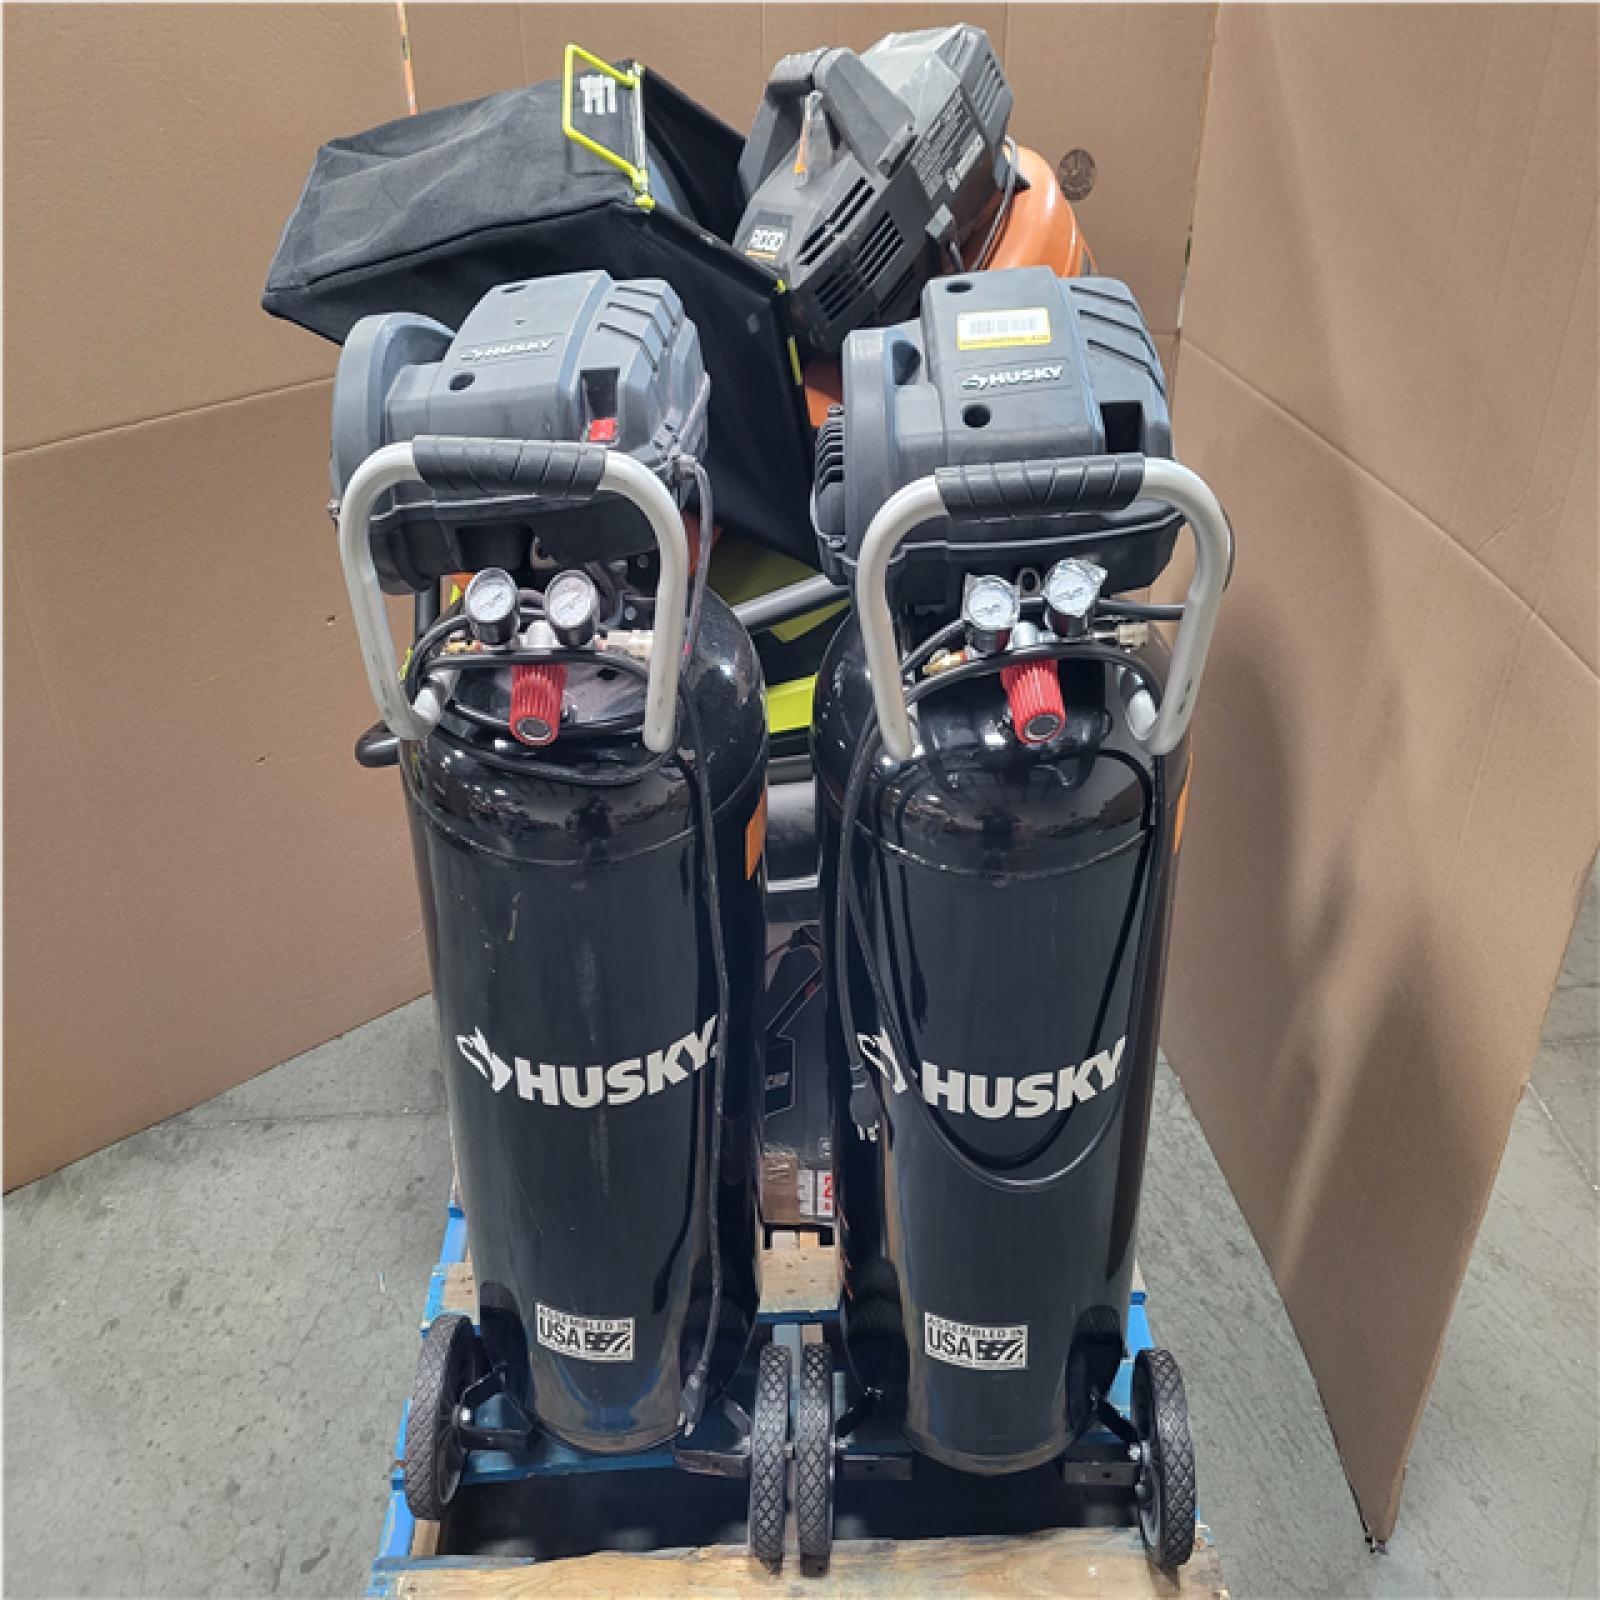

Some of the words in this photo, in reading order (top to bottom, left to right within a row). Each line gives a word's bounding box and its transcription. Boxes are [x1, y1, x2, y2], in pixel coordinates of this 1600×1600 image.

[484, 338, 556, 356] HUSKY
[989, 364, 1064, 387] HUSKY
[514, 1014, 718, 1109] HUSKY
[921, 1035, 1127, 1119] HUSKY
[539, 1316, 581, 1350] USA
[928, 1326, 972, 1358] USA
